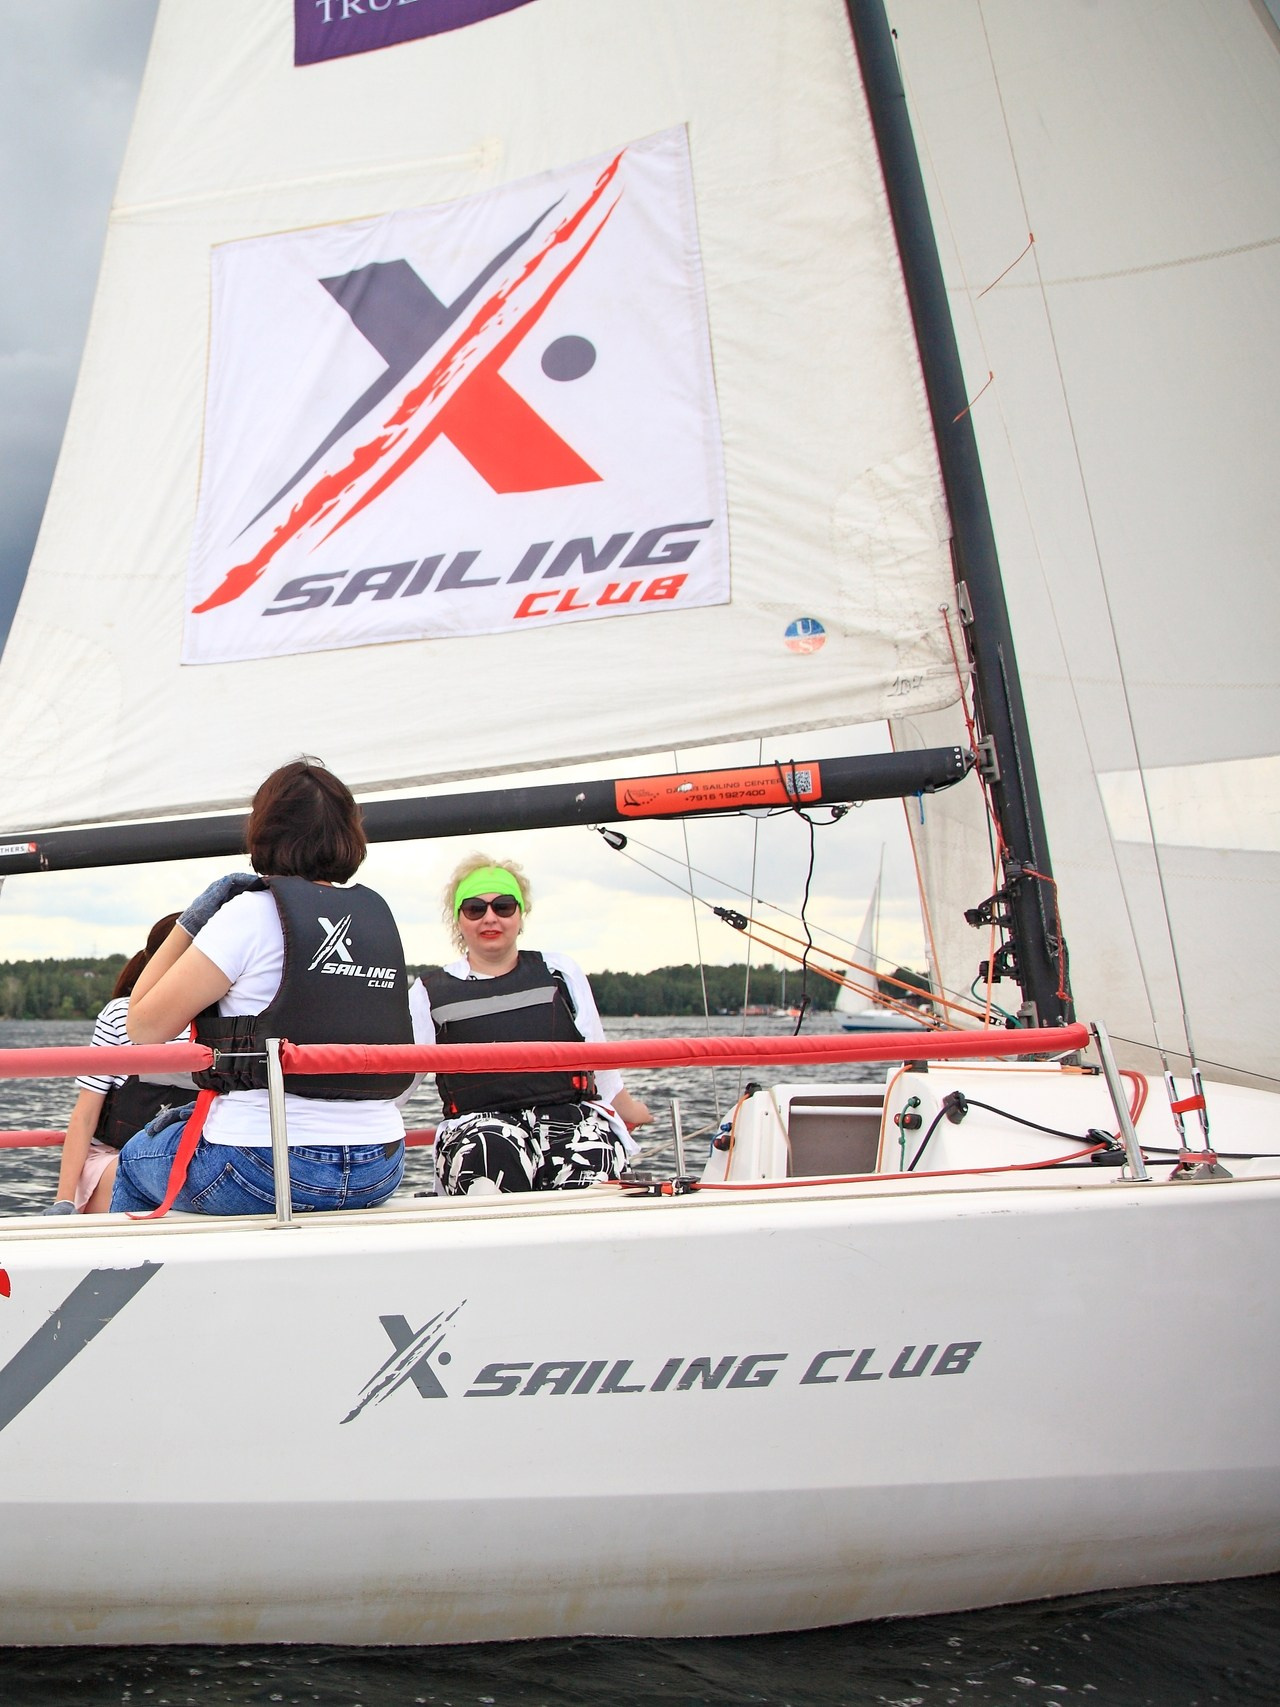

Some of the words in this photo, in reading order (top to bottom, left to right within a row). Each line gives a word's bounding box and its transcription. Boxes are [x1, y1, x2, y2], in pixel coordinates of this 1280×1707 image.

[262, 519, 714, 617] SAILING
[512, 573, 690, 621] CLUB
[702, 783, 740, 791] SAILING
[321, 962, 397, 980] SAILING
[367, 979, 395, 989] CLUB
[463, 1353, 789, 1398] SAILING
[799, 1341, 982, 1386] CLUB
